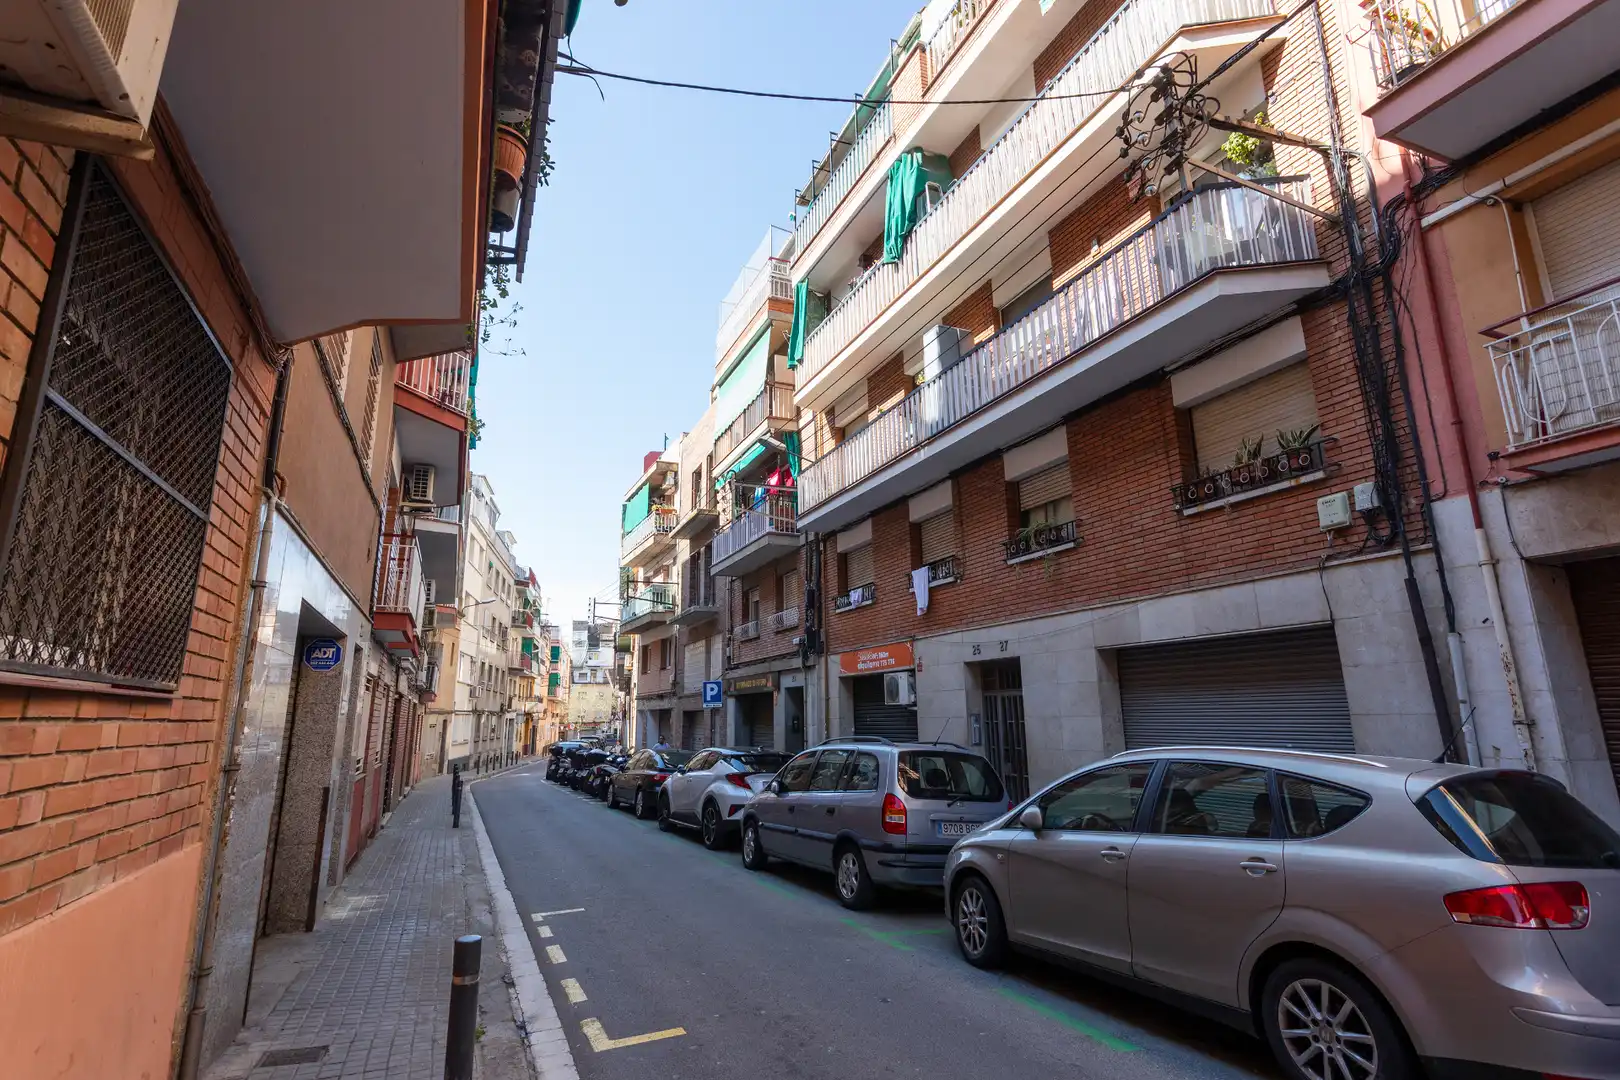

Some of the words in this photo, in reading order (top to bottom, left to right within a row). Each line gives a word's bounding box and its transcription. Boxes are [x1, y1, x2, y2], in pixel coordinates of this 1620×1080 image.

[311, 648, 336, 658] ADT
[972, 645, 982, 656] 25
[999, 640, 1009, 652] 27
[706, 683, 719, 701] P
[943, 823, 964, 834] 9708
